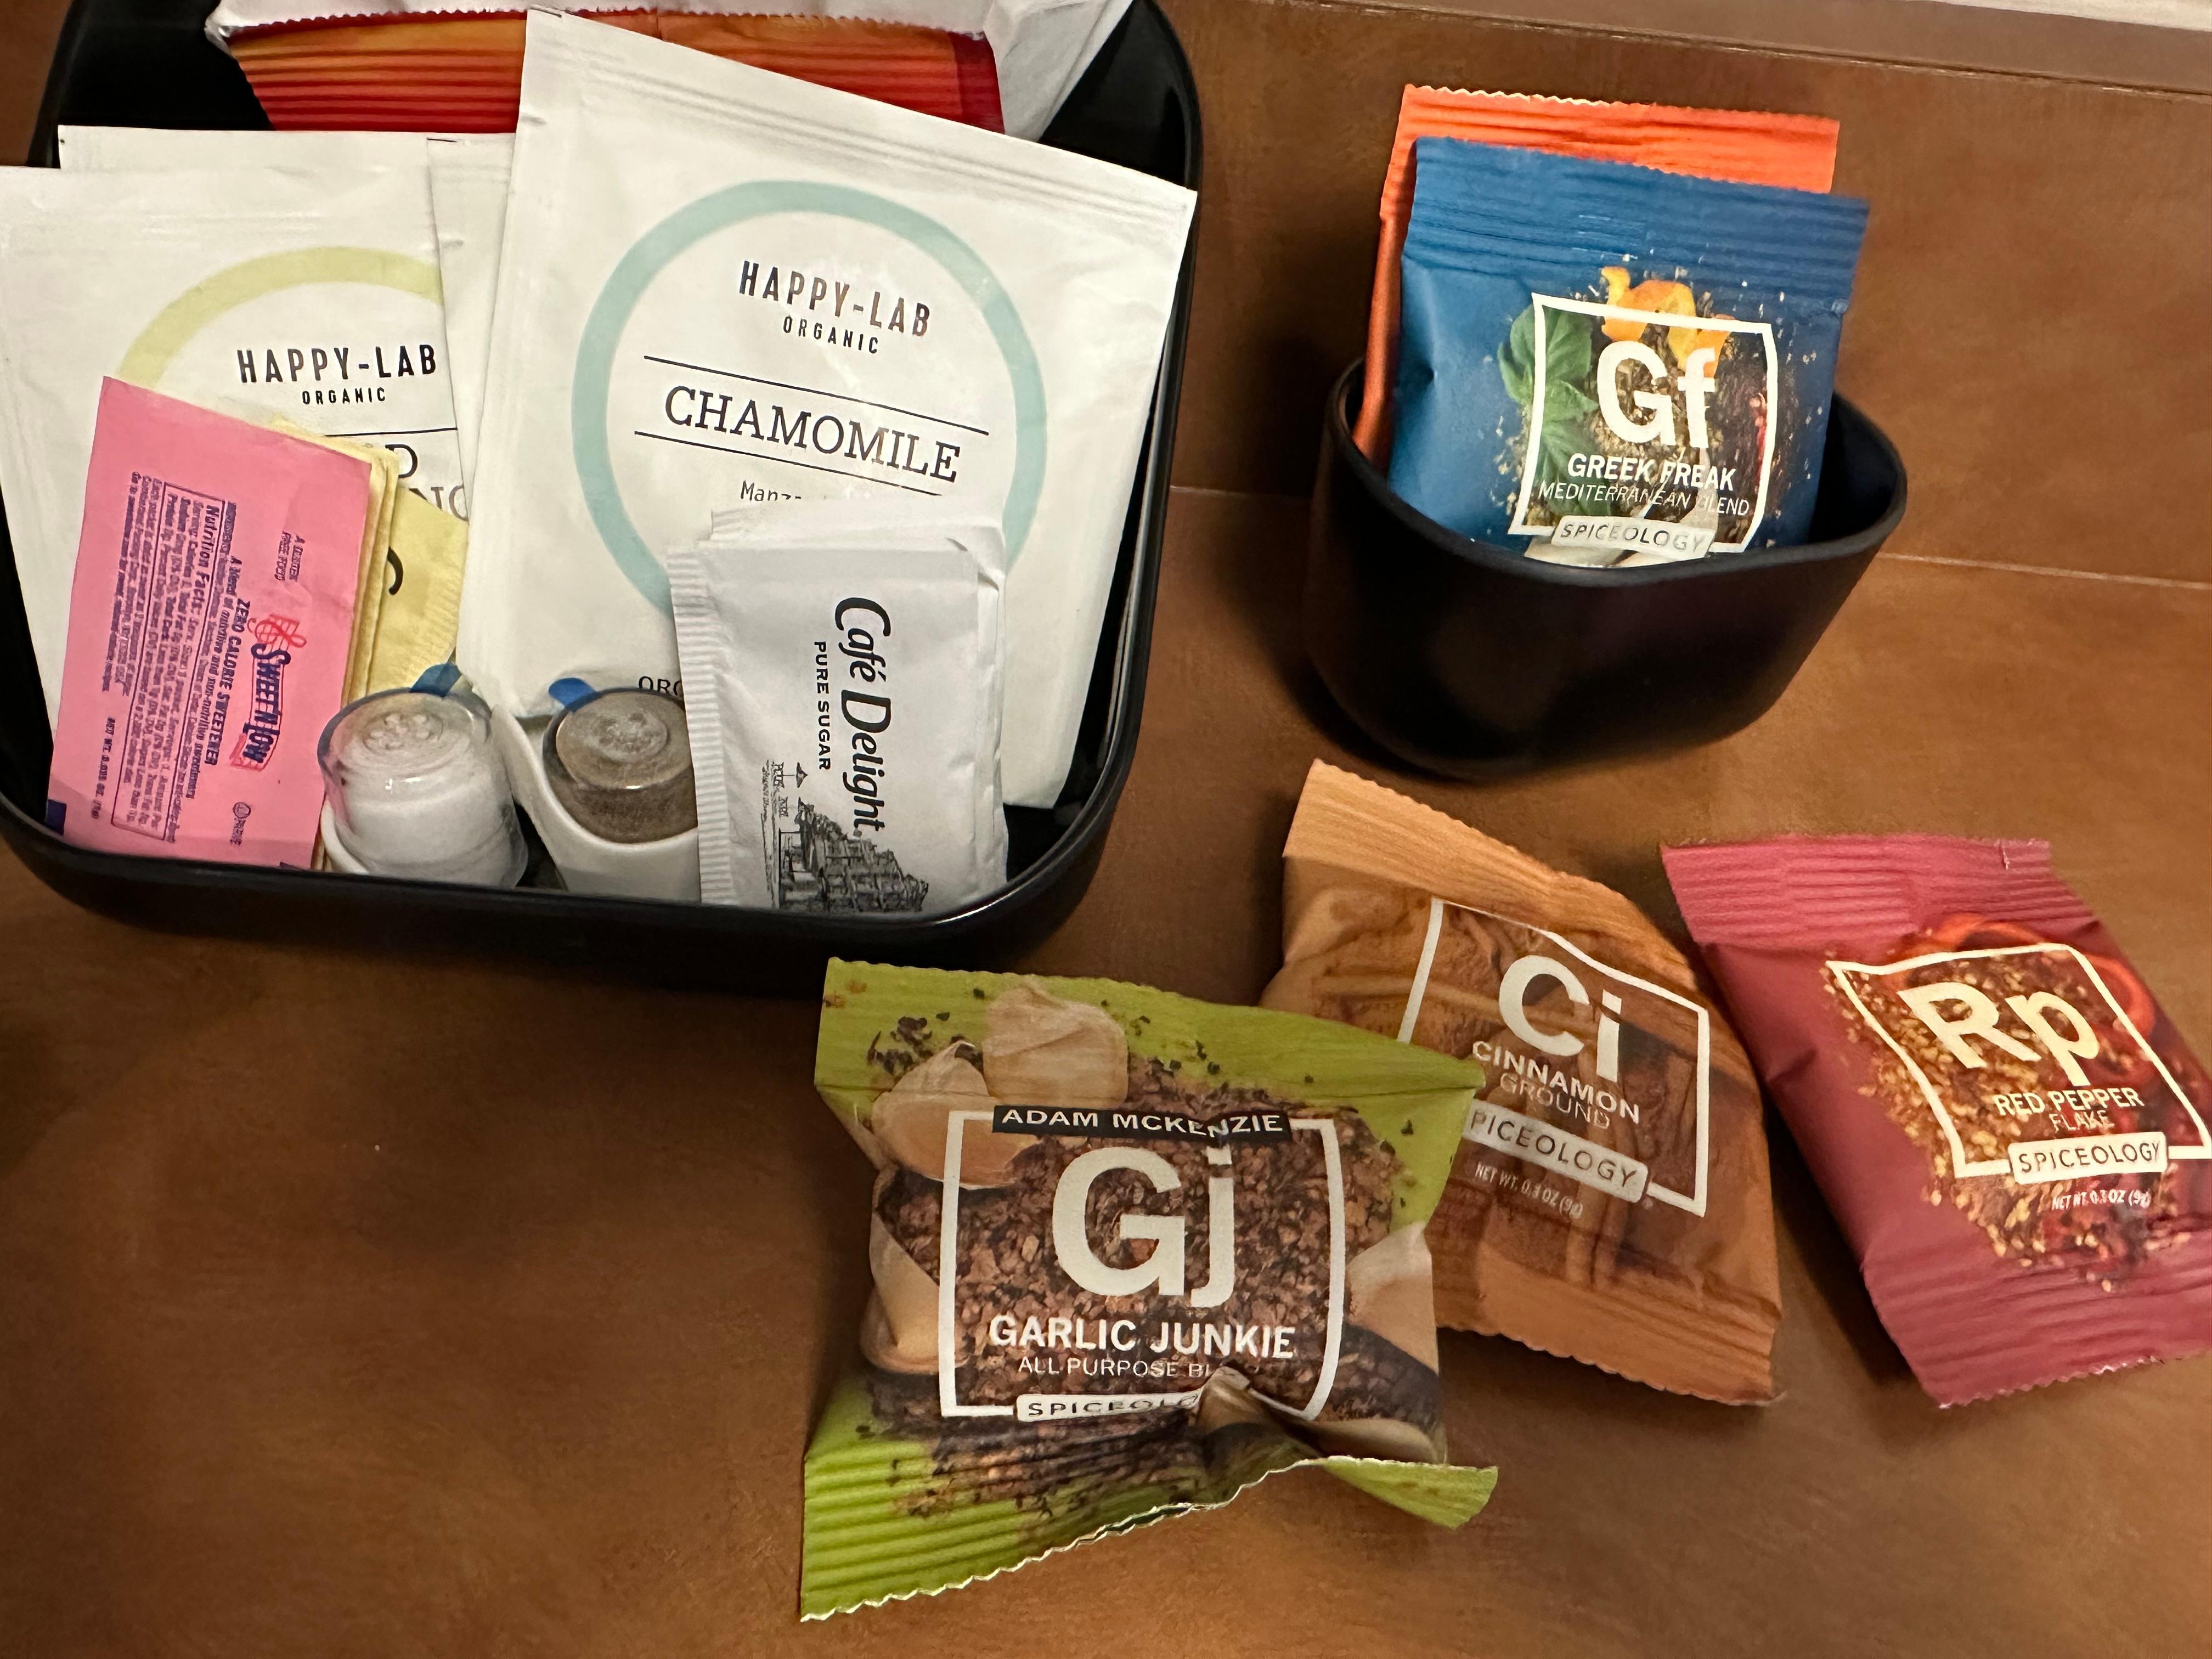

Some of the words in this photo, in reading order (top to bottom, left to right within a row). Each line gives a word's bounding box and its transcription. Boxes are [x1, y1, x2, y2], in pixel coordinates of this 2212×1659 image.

[740, 261, 930, 337] HAPPY-LAB
[783, 316, 878, 353] ORGANIC
[237, 344, 437, 383] HAPPY-LAB
[302, 386, 386, 405] ORGANIC
[1597, 340, 1717, 449] Gf
[665, 386, 961, 482] CHAMOMILE
[1568, 453, 1650, 482] GREEK
[1660, 460, 1736, 491] FREAK
[1538, 481, 1692, 509] MEDITERRANEAN
[199, 505, 219, 567] Nutrition
[1561, 523, 1703, 552] SPICEOLOGY
[232, 599, 250, 632] ZERO
[834, 597, 891, 683] Café
[219, 636, 241, 690] CALORIE
[814, 640, 830, 695] PURE
[205, 692, 230, 765] SWEETENER
[242, 723, 280, 764] LOW
[817, 700, 831, 770] SUGAR
[1498, 955, 1622, 1083] Ci
[1897, 982, 2100, 1087] Rp
[1472, 1041, 1639, 1124] CINNAMON
[1500, 1073, 1610, 1129] GROUND
[1993, 1093, 2045, 1116] RED
[2047, 1087, 2145, 1111] PEPPER
[1002, 1109, 1098, 1127] ADAM
[1112, 1113, 1283, 1138] MCKENZIE
[2049, 1110, 2115, 1133] FLAKE
[1471, 1109, 1637, 1187] PICEOLOGY
[2019, 1142, 2160, 1173] SPICEOLOGY
[1475, 1162, 1498, 1183] NET
[2051, 1194, 2072, 1211] NET
[2108, 1189, 2125, 1203] OZ
[1052, 1146, 1236, 1309] Gj
[988, 1314, 1137, 1352] GARLIC
[1149, 1322, 1295, 1359] JUNKIE
[1018, 1356, 1060, 1375] ALL
[1068, 1358, 1178, 1378] PURPOSE
